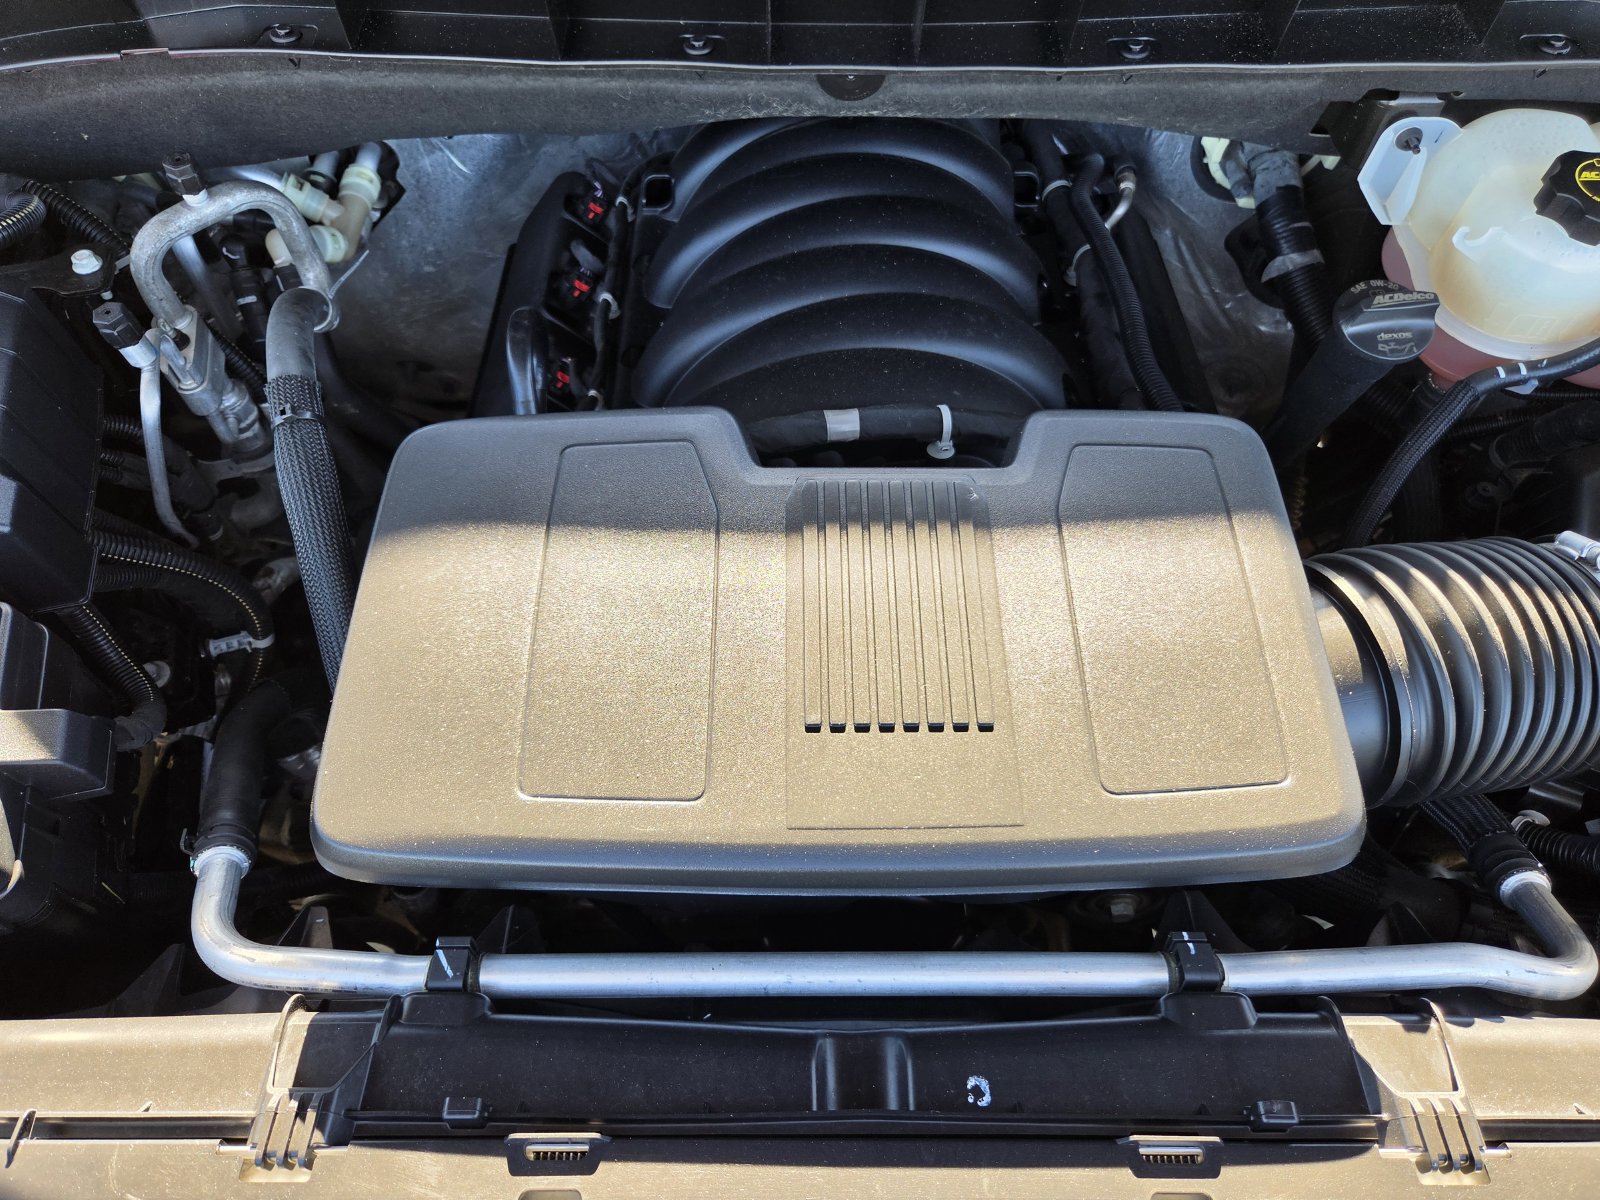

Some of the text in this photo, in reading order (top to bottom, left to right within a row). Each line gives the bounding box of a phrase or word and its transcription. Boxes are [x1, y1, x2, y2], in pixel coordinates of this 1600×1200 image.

[1350, 280, 1399, 294] SAE 0W-20
[1372, 291, 1435, 305] ACDelco
[1376, 332, 1413, 341] dexos
